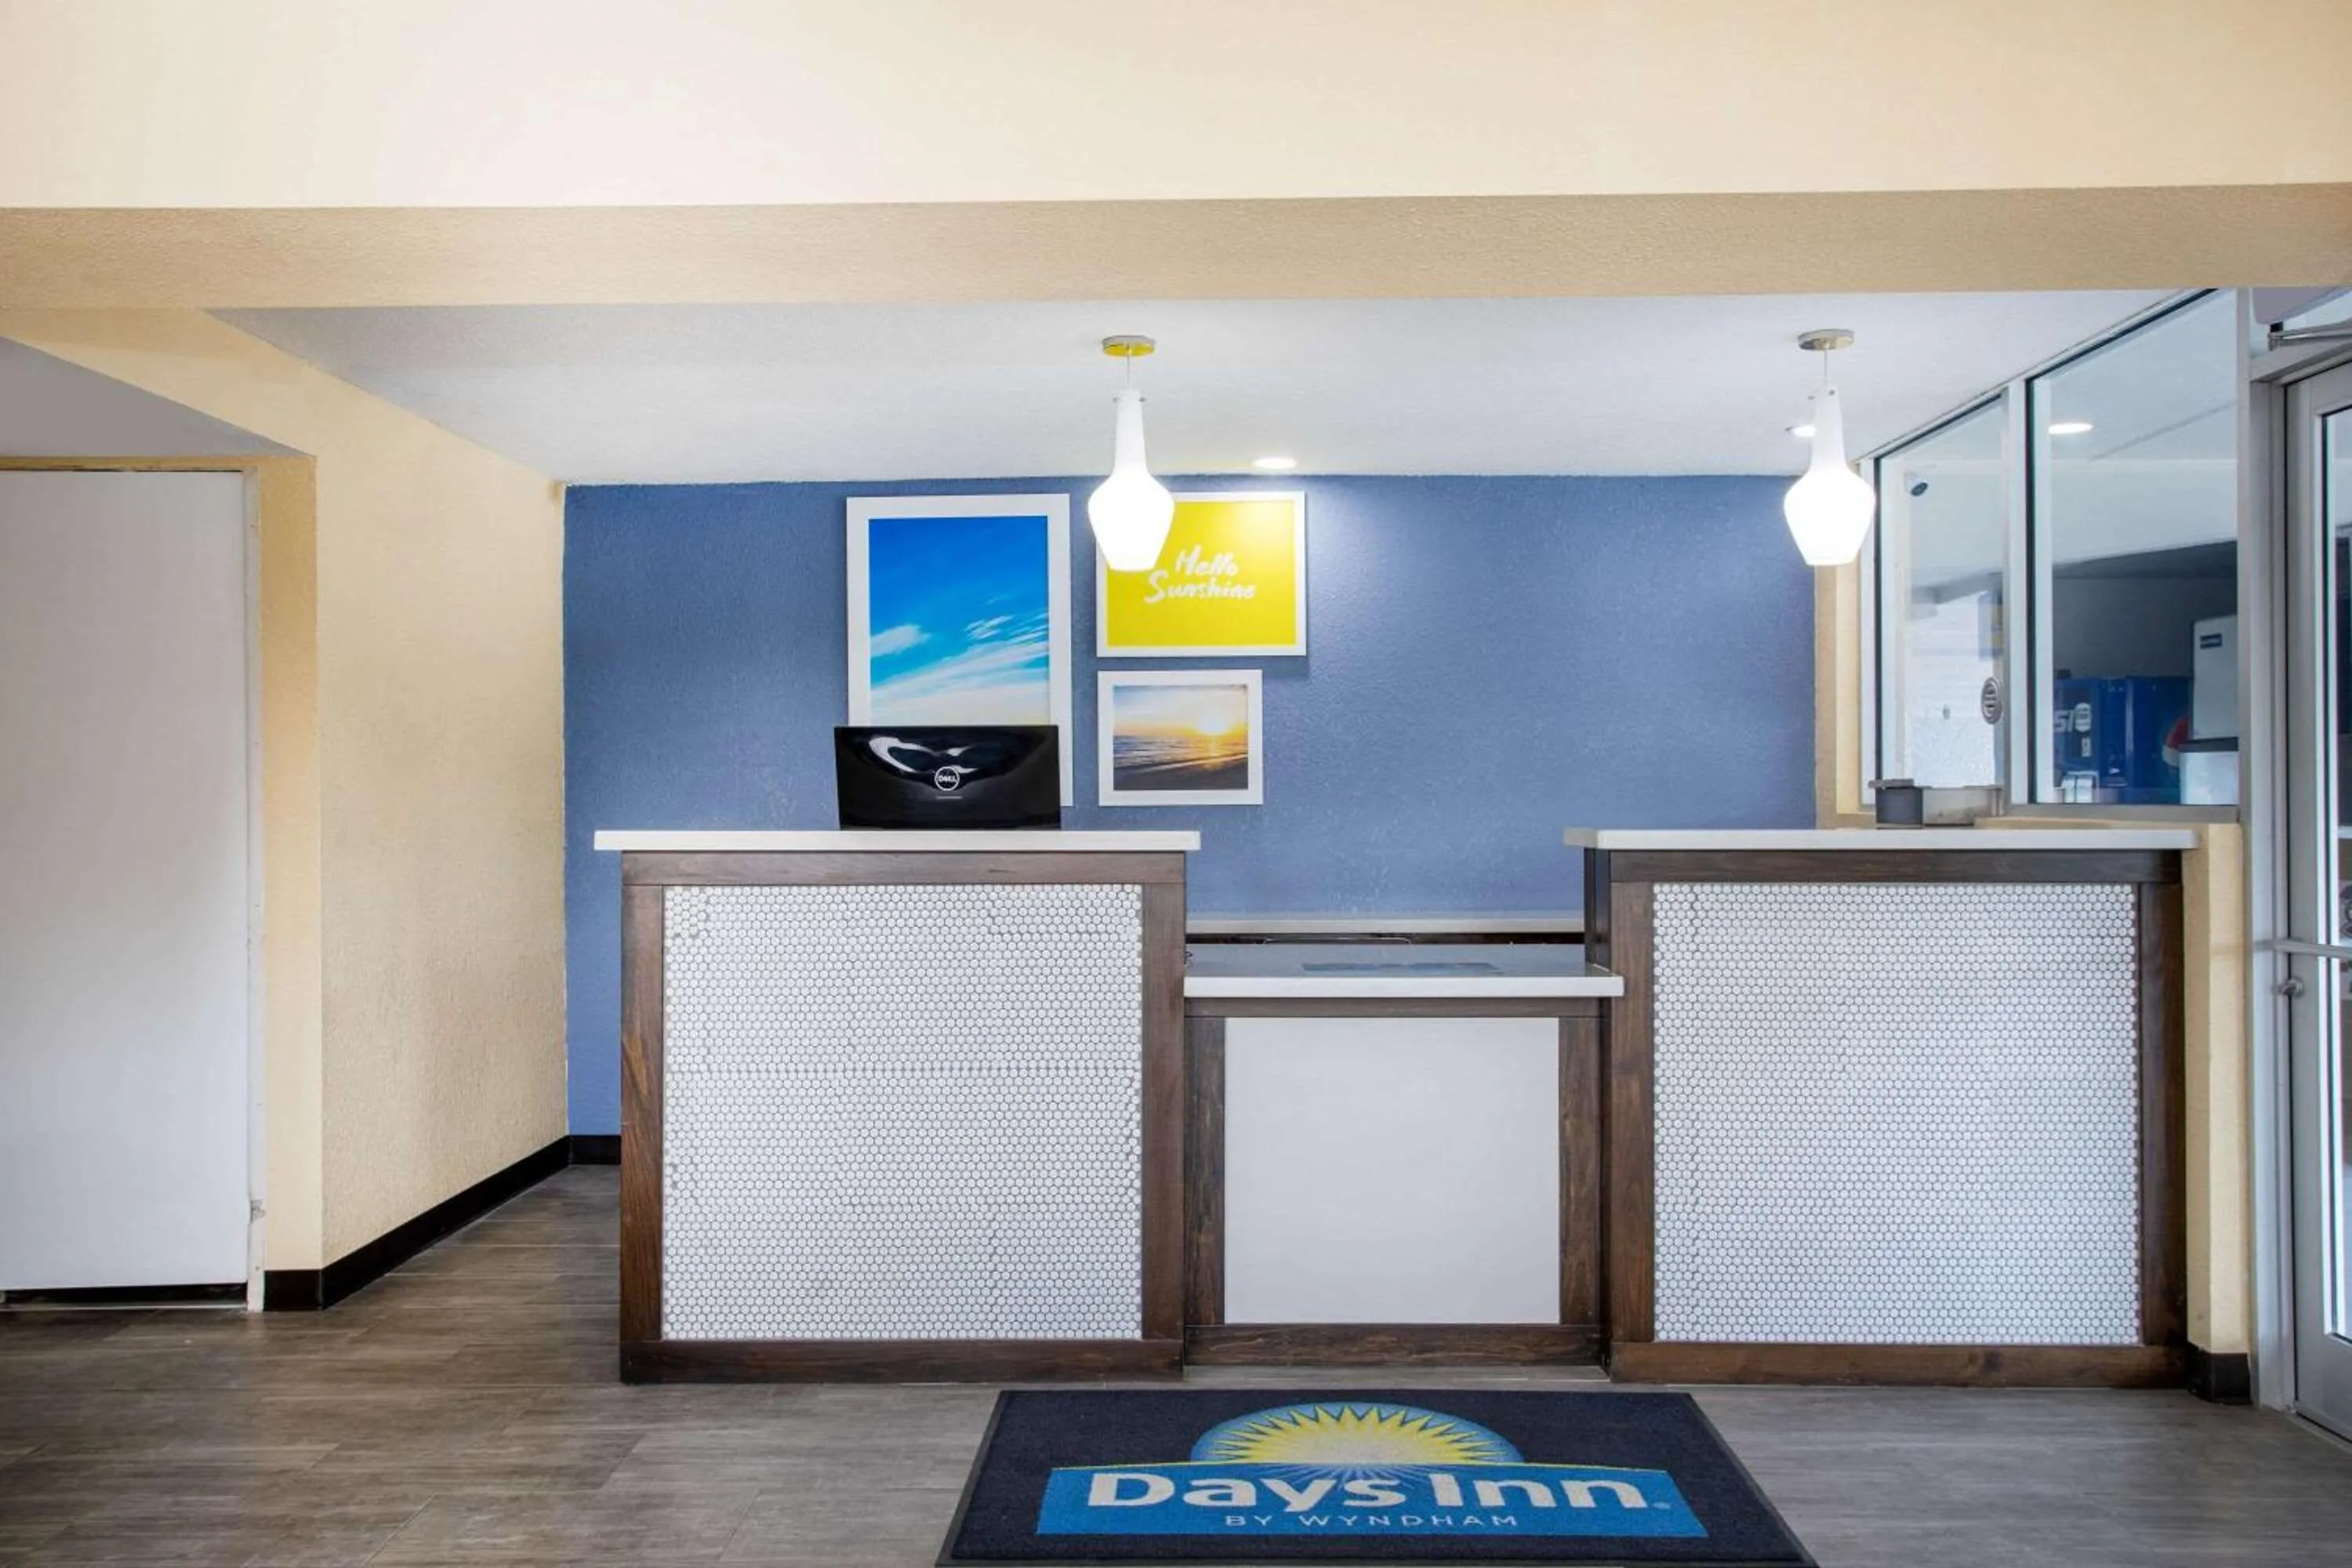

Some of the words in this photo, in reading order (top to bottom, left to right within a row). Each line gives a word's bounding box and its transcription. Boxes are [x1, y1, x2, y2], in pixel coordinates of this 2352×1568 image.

[1176, 544, 1238, 577] Hello
[1143, 569, 1256, 604] Sunshine
[1088, 1472, 1406, 1512] Days
[1429, 1473, 1648, 1508] Inn
[1225, 1515, 1272, 1526] BY
[1298, 1515, 1518, 1526] WYNDHAM
